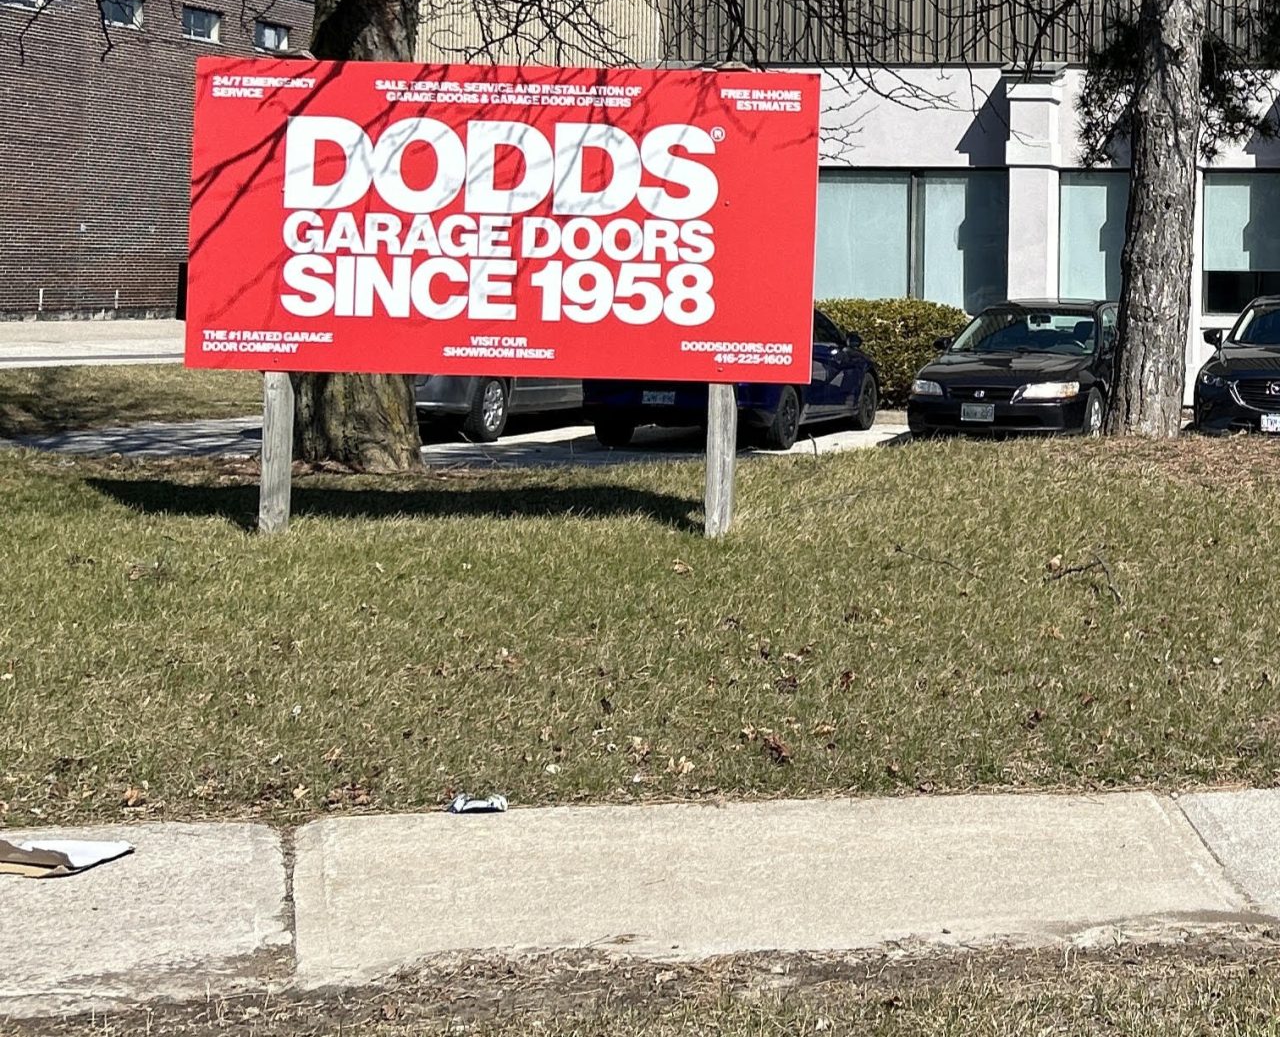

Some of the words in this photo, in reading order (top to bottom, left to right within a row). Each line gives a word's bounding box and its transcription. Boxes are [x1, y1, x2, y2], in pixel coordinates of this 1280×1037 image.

[213, 75, 240, 86] 24/7
[242, 76, 316, 88] EMERGENCY
[212, 87, 264, 98] SERVICE
[410, 81, 463, 93] REPAIRS,
[463, 82, 512, 93] SERVICE
[514, 84, 540, 94] AND
[541, 84, 624, 96] INSTALLATION
[625, 86, 642, 96] OF
[720, 88, 750, 99] FREE
[751, 89, 802, 100] IN-HOME
[385, 92, 436, 102] GARAGE
[437, 93, 479, 103] DOORS
[480, 93, 489, 103] &
[490, 94, 539, 105] GARAGE
[541, 95, 575, 106] DOOR
[576, 96, 632, 107] OPENERS
[736, 100, 802, 112] ESTIMATES
[283, 210, 512, 258] GARAGE
[521, 217, 716, 263] DOORS
[280, 255, 518, 321] SINCE
[530, 261, 716, 327] 1958
[203, 330, 228, 340] THE
[228, 331, 241, 341] #1
[242, 331, 281, 341] RATED
[283, 332, 333, 343] GARAGE
[470, 336, 500, 346] VISIT
[501, 337, 528, 347] OUR
[202, 341, 238, 352] DOOR
[239, 342, 299, 353] COMPANY
[443, 346, 516, 358] SHOWROOM
[516, 348, 555, 359] INSIDE
[681, 341, 793, 353] DODDSDOORS.COM
[714, 353, 793, 365] 416-225-1600
